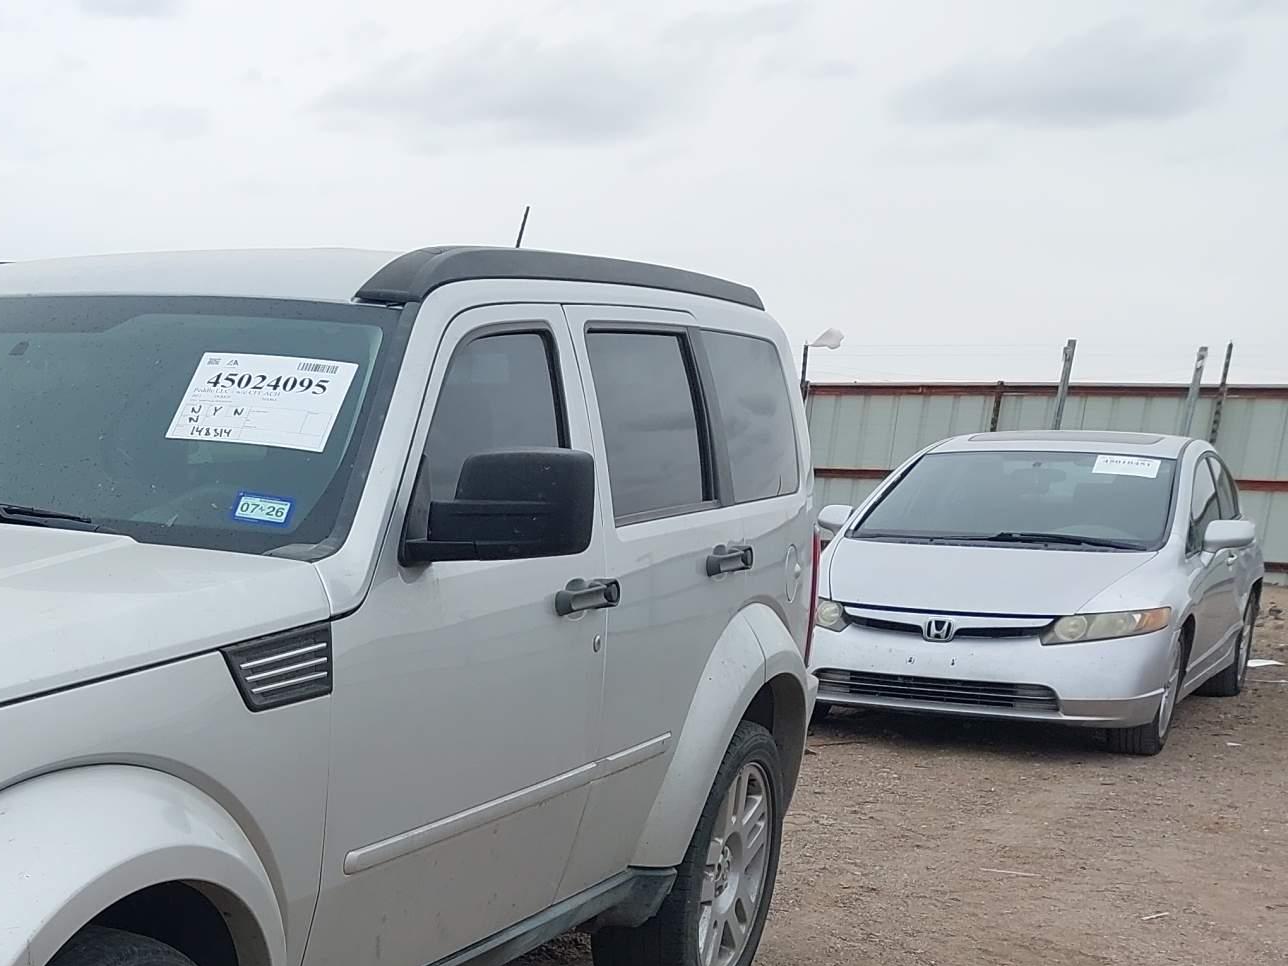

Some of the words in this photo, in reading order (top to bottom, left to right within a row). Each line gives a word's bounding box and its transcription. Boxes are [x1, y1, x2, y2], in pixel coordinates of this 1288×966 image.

[207, 372, 330, 395] 45024095
[213, 406, 223, 416] Y
[233, 407, 244, 416] N
[240, 502, 260, 514] 07
[265, 505, 286, 518] 26
